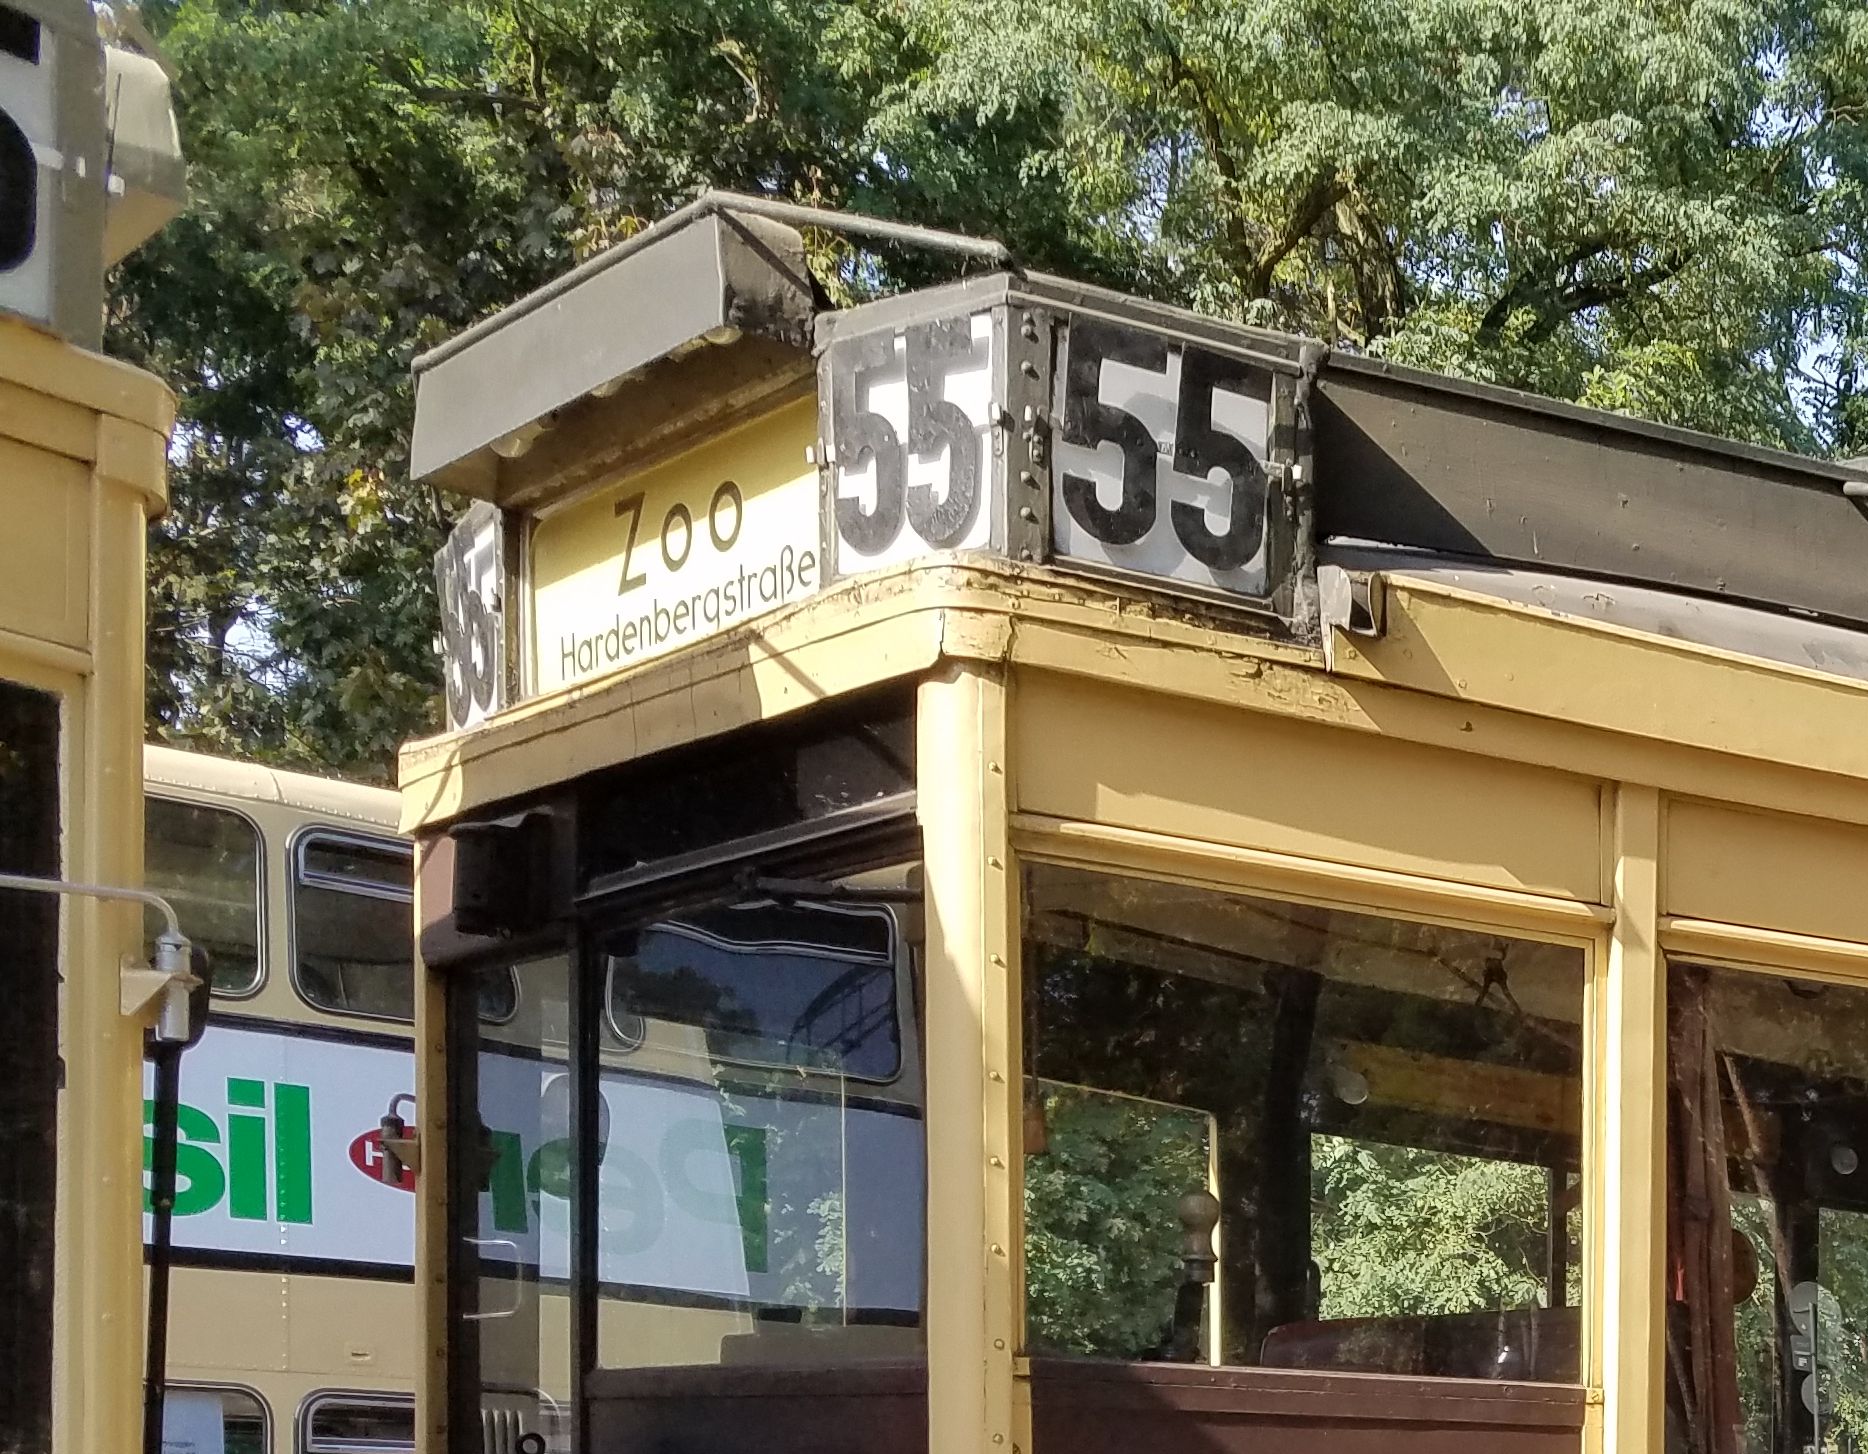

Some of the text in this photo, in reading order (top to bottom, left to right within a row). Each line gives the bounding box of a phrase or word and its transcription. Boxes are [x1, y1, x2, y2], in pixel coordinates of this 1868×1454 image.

[831, 319, 978, 557] 55
[1062, 312, 1271, 571] 55
[561, 544, 816, 681] Hardenbergstraße
[613, 480, 743, 596] Zoo
